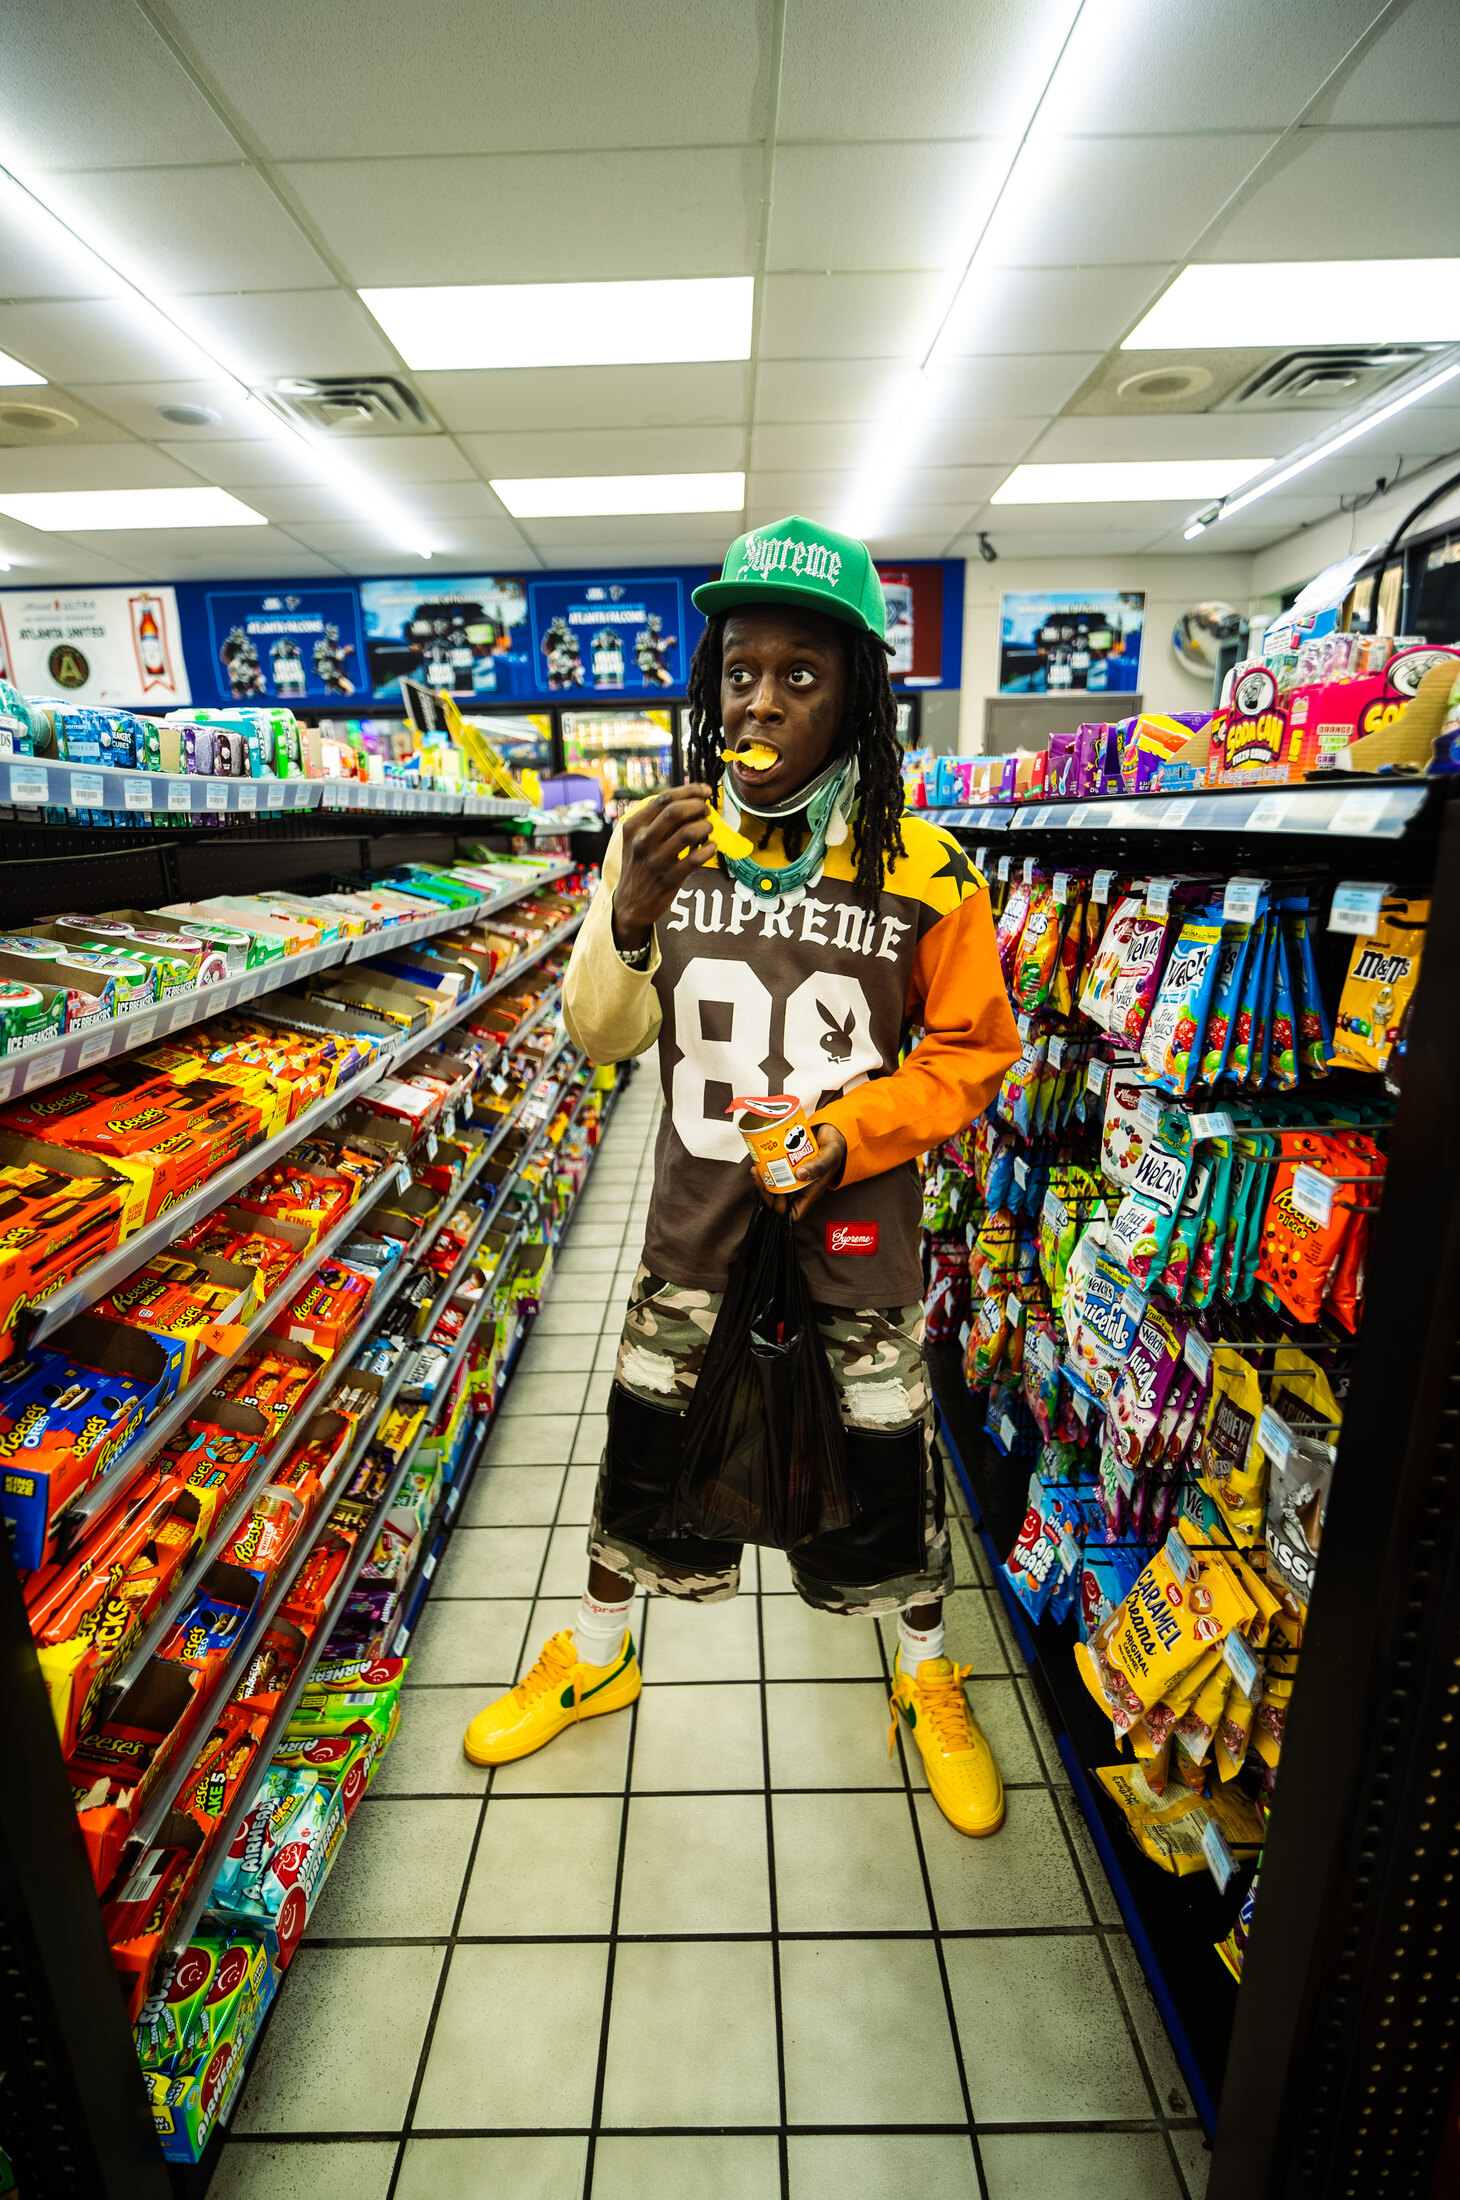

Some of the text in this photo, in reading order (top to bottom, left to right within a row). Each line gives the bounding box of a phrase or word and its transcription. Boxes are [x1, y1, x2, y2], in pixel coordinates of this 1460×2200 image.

[736, 534, 842, 587] Supreme
[568, 610, 647, 625] ATLANTA FALCONS
[19, 625, 105, 640] ATLANTA UNITED
[1226, 720, 1256, 763] SODA
[1256, 714, 1284, 753] CAN
[1319, 726, 1351, 734] ORANGE
[1319, 736, 1347, 744] LEMON
[666, 888, 912, 963] SUPREME
[163, 981, 195, 999] ICE BREAKERS
[118, 995, 154, 1015] ICE BREAKERS
[69, 1008, 112, 1032] ICE BREAKERS
[7, 1023, 59, 1054] ICE BREAKERS
[28, 1090, 91, 1117] Reese's
[105, 1107, 166, 1134] Reese's
[759, 1139, 773, 1150] GRAB
[768, 1141, 779, 1152] GO
[788, 1140, 815, 1166] PRINGLES
[126, 1208, 143, 1225] SIZE
[127, 1199, 145, 1213] KING
[1124, 1208, 1147, 1229] Fruit
[284, 1214, 313, 1228] KING
[1111, 1215, 1139, 1242] Snacks
[831, 1227, 874, 1251] Supreme
[111, 1277, 159, 1314] Reese's
[139, 1285, 168, 1306] BIG CUP
[1087, 1277, 1114, 1298] Welch's
[292, 1286, 323, 1322] Reese's
[1095, 1343, 1121, 1362] MIXED FRUIT
[1125, 1345, 1157, 1410] Juicels
[0, 1403, 50, 1458] Reese's
[23, 1415, 50, 1449] OREO
[68, 1416, 109, 1462] eese's
[90, 1404, 146, 1485] Reese's
[4, 1483, 34, 1497] SIZE
[5, 1475, 35, 1487] KING
[155, 1522, 177, 1542] KING
[166, 1525, 188, 1545] SIZE
[233, 1512, 265, 1564] Reese's
[260, 1529, 275, 1551] WHITE
[1013, 1543, 1049, 1582] HEADS
[1031, 1537, 1056, 1567] AIR
[304, 1601, 316, 1609] 18
[1137, 1568, 1183, 1655] CARAMEL
[1125, 1589, 1157, 1656] Creams
[1122, 1641, 1139, 1673] CARAMEL
[1124, 1629, 1151, 1678] ORIGINAL
[206, 1772, 226, 1817] AKE 5
[1111, 1775, 1136, 1807] Werther's
[271, 1795, 296, 1824] bites
[196, 2032, 245, 2147] AIRHEADS
